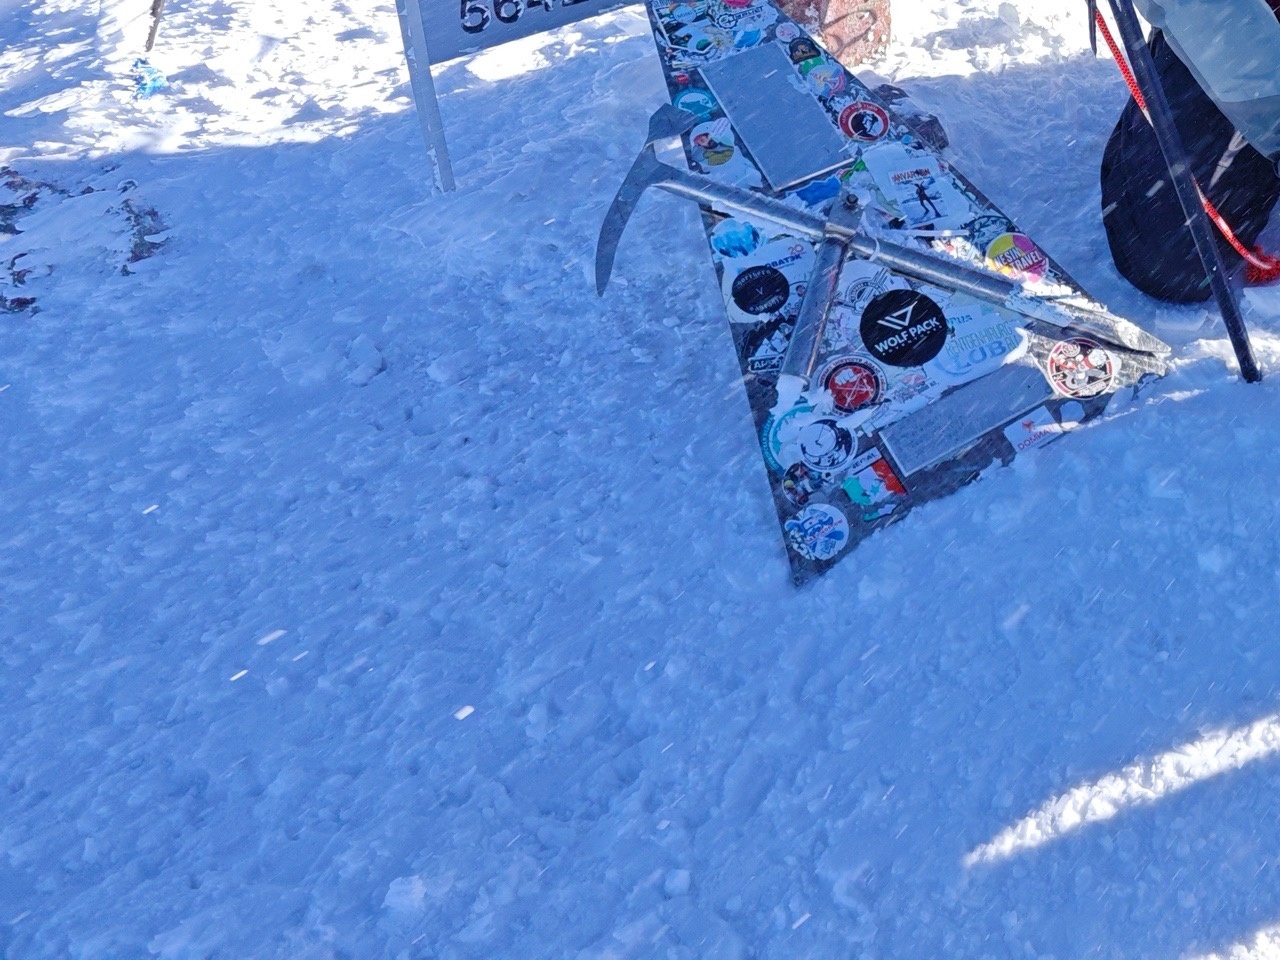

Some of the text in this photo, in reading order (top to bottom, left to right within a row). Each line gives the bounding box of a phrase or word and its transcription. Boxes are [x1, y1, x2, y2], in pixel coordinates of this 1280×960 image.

[1010, 251, 1043, 273] TRAVEL
[874, 332, 910, 354] WOLF
[909, 317, 941, 339] PACK
